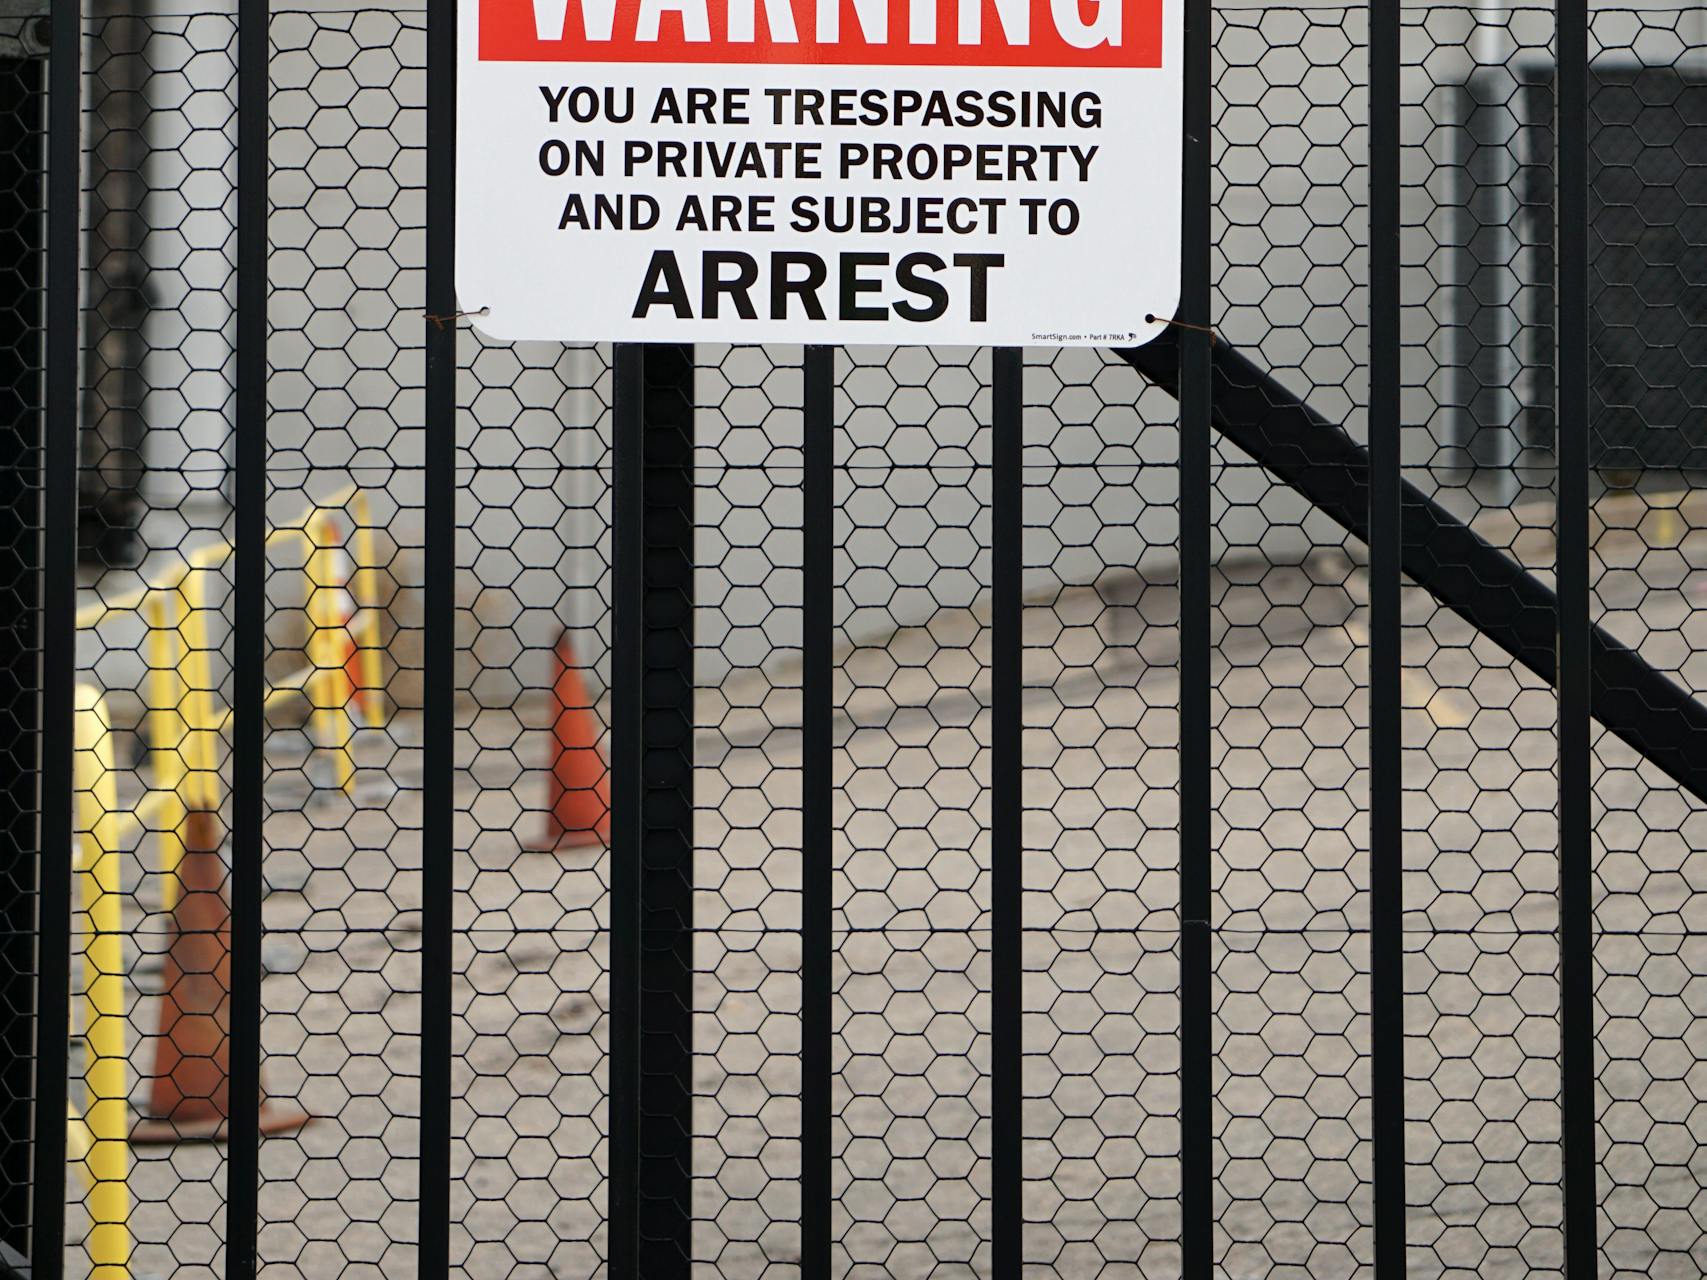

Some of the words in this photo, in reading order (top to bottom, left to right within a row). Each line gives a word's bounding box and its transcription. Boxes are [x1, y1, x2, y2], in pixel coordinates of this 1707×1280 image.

[539, 86, 633, 123] YOU
[651, 88, 749, 124] ARE
[765, 89, 1101, 128] TRESPASSING
[539, 140, 603, 176] ON
[625, 141, 821, 178] PRIVATE
[840, 143, 1099, 181] PROPERTY
[559, 194, 659, 230] AND
[676, 195, 774, 231] ARE
[790, 196, 1006, 234] SUBJECT
[1020, 199, 1079, 235] TO
[632, 250, 1004, 322] ARREST
[1031, 332, 1082, 342] SmartSign.com
[1089, 333, 1103, 341] Part
